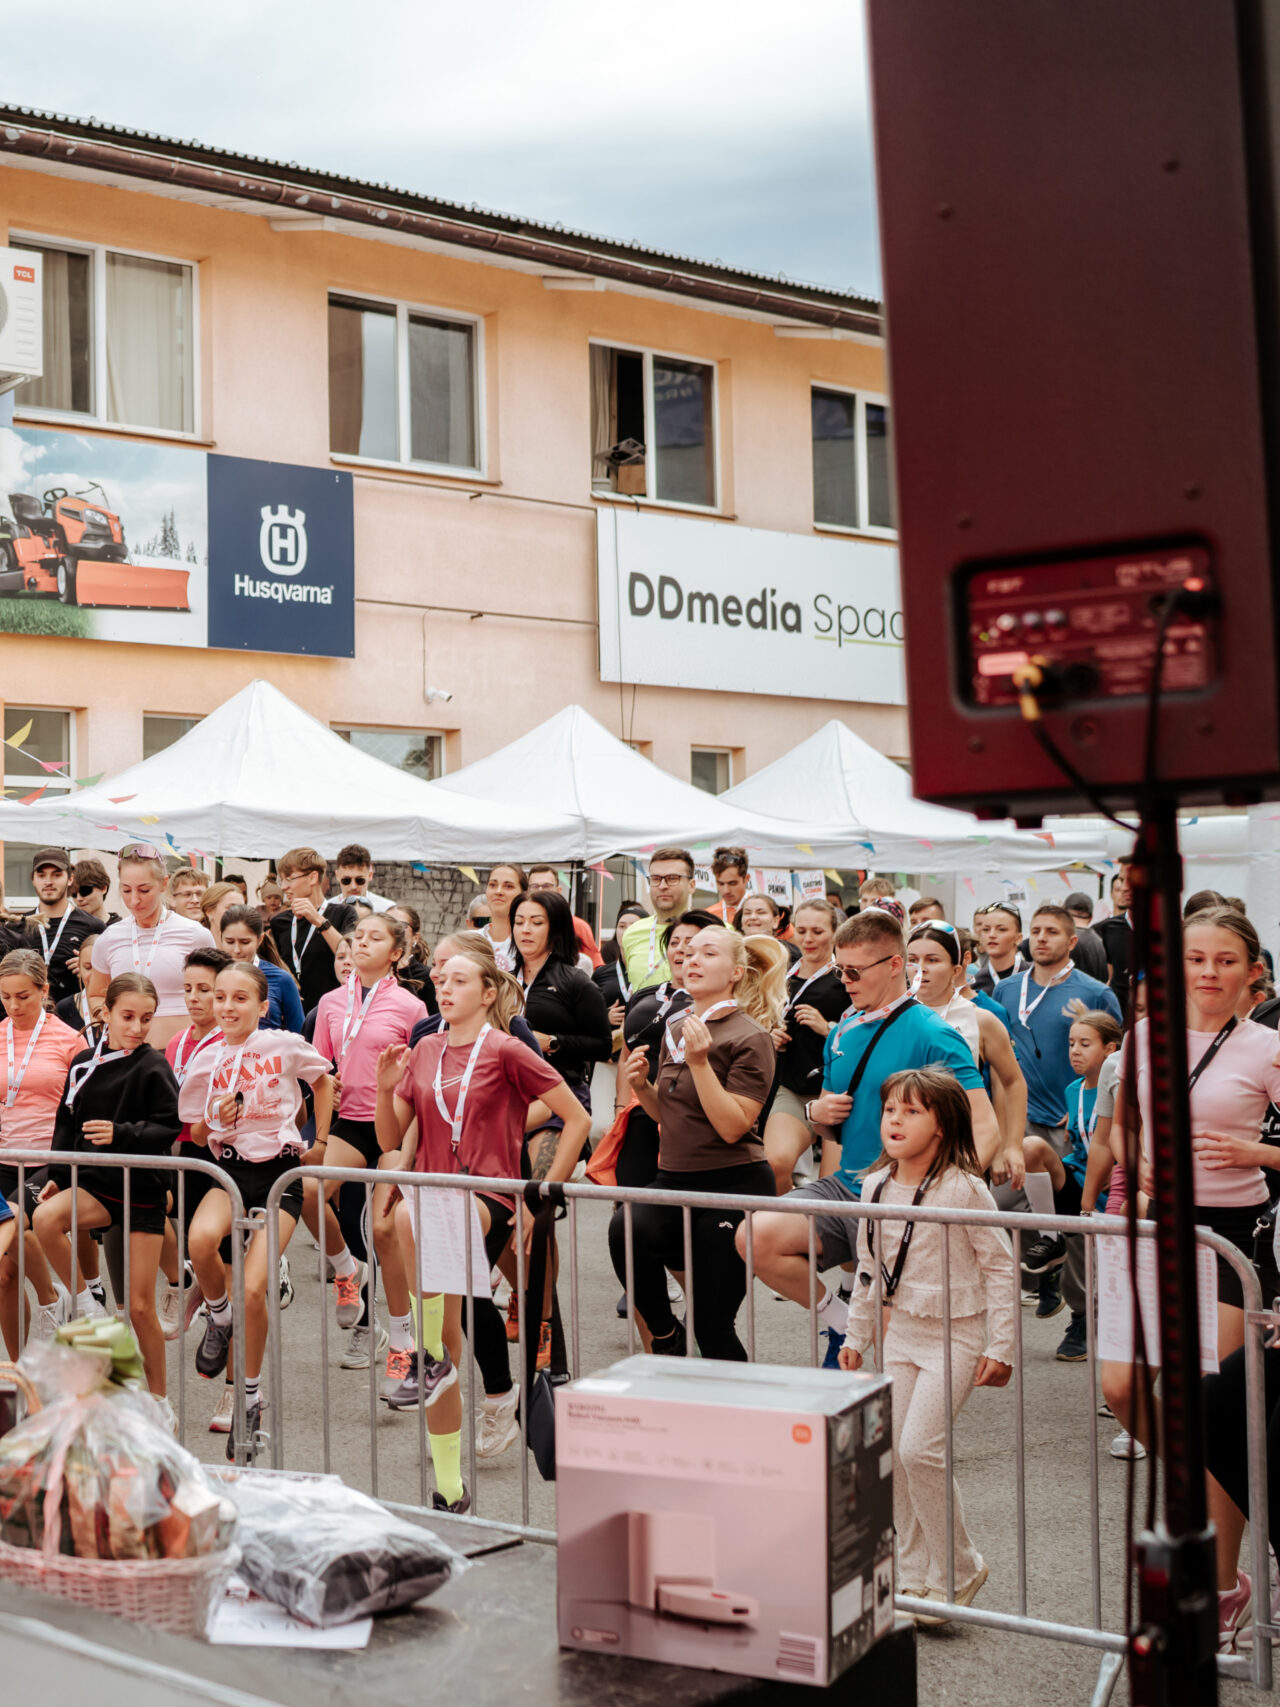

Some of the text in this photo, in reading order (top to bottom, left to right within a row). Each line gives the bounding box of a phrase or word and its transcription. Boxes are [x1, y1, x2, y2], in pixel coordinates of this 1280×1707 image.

[16, 270, 33, 279] TCL
[234, 573, 332, 604] Husqvarna
[628, 571, 905, 648] DDmedia Spac
